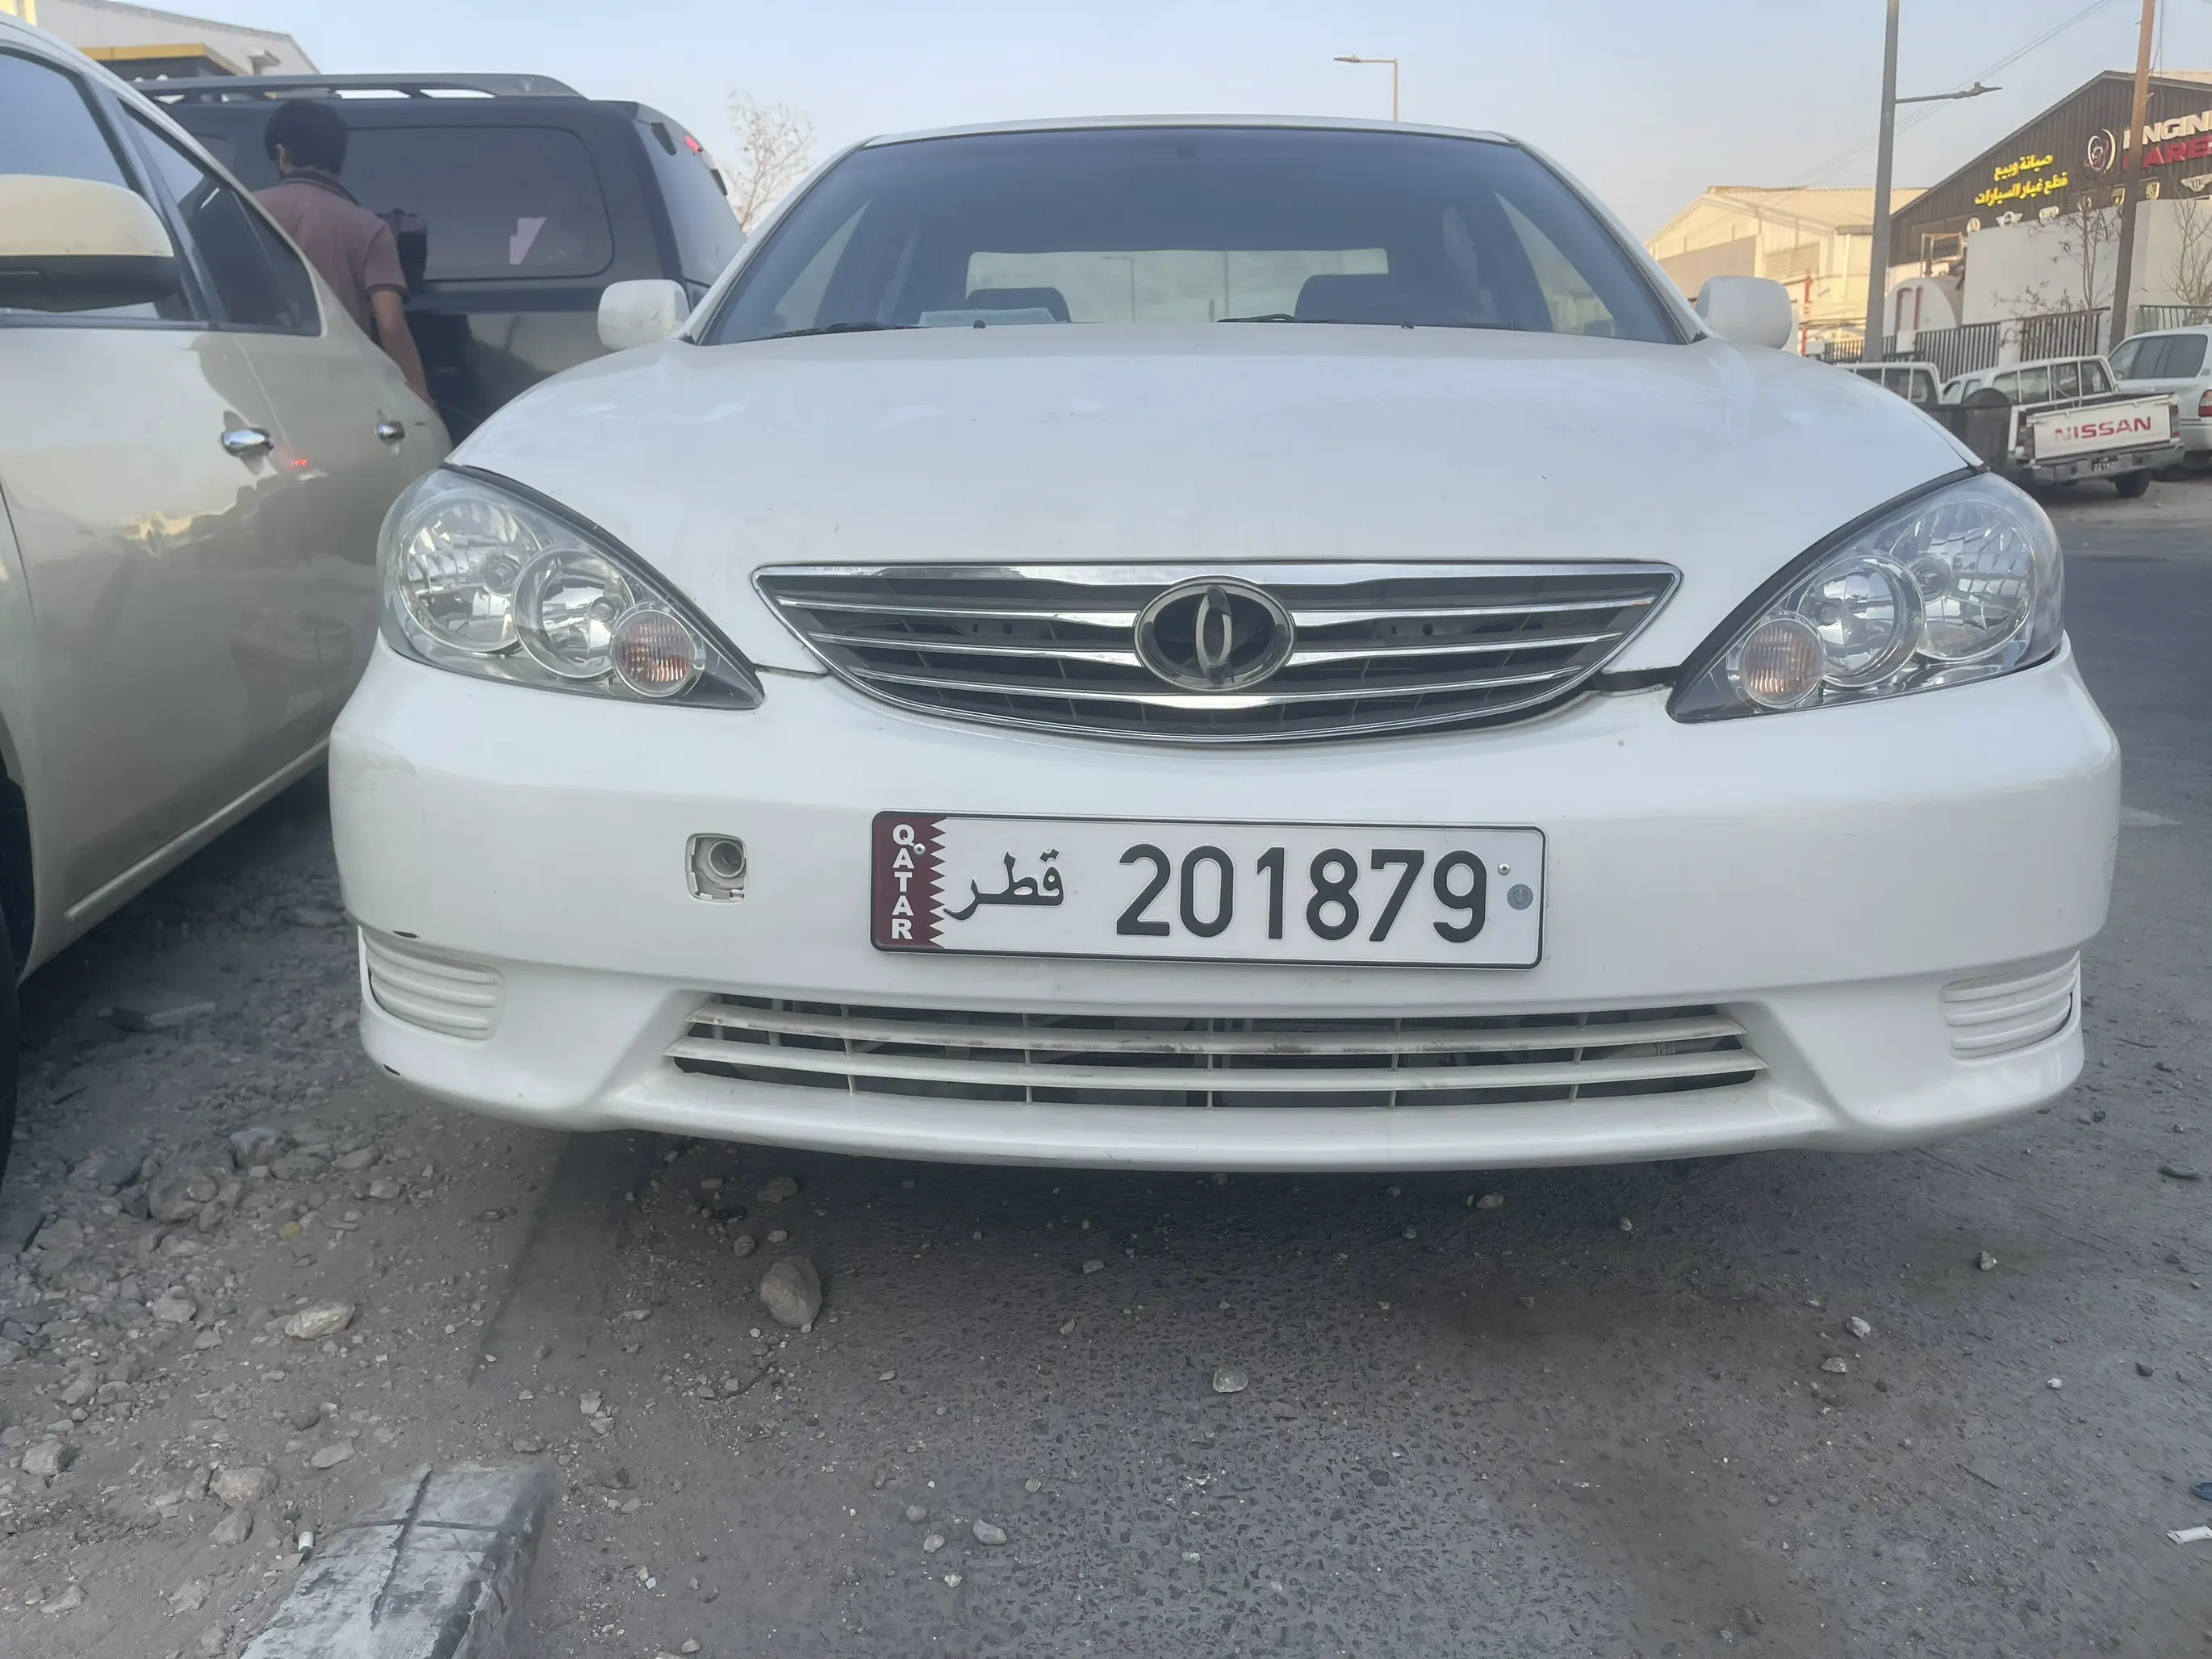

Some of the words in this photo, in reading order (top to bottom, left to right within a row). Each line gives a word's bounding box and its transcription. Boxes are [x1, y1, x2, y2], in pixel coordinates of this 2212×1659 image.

[2122, 110, 2212, 150] NGIN
[1994, 161, 2019, 182] وبيع
[2019, 154, 2054, 173] صيانة
[1974, 182, 2022, 207] السيارات
[2019, 178, 2043, 199] غيار
[2043, 171, 2068, 195] قطع
[2055, 416, 2151, 441] NISSAN
[892, 824, 915, 940] QATAR
[943, 848, 1064, 921] قطر
[1116, 843, 1487, 943] 201879
